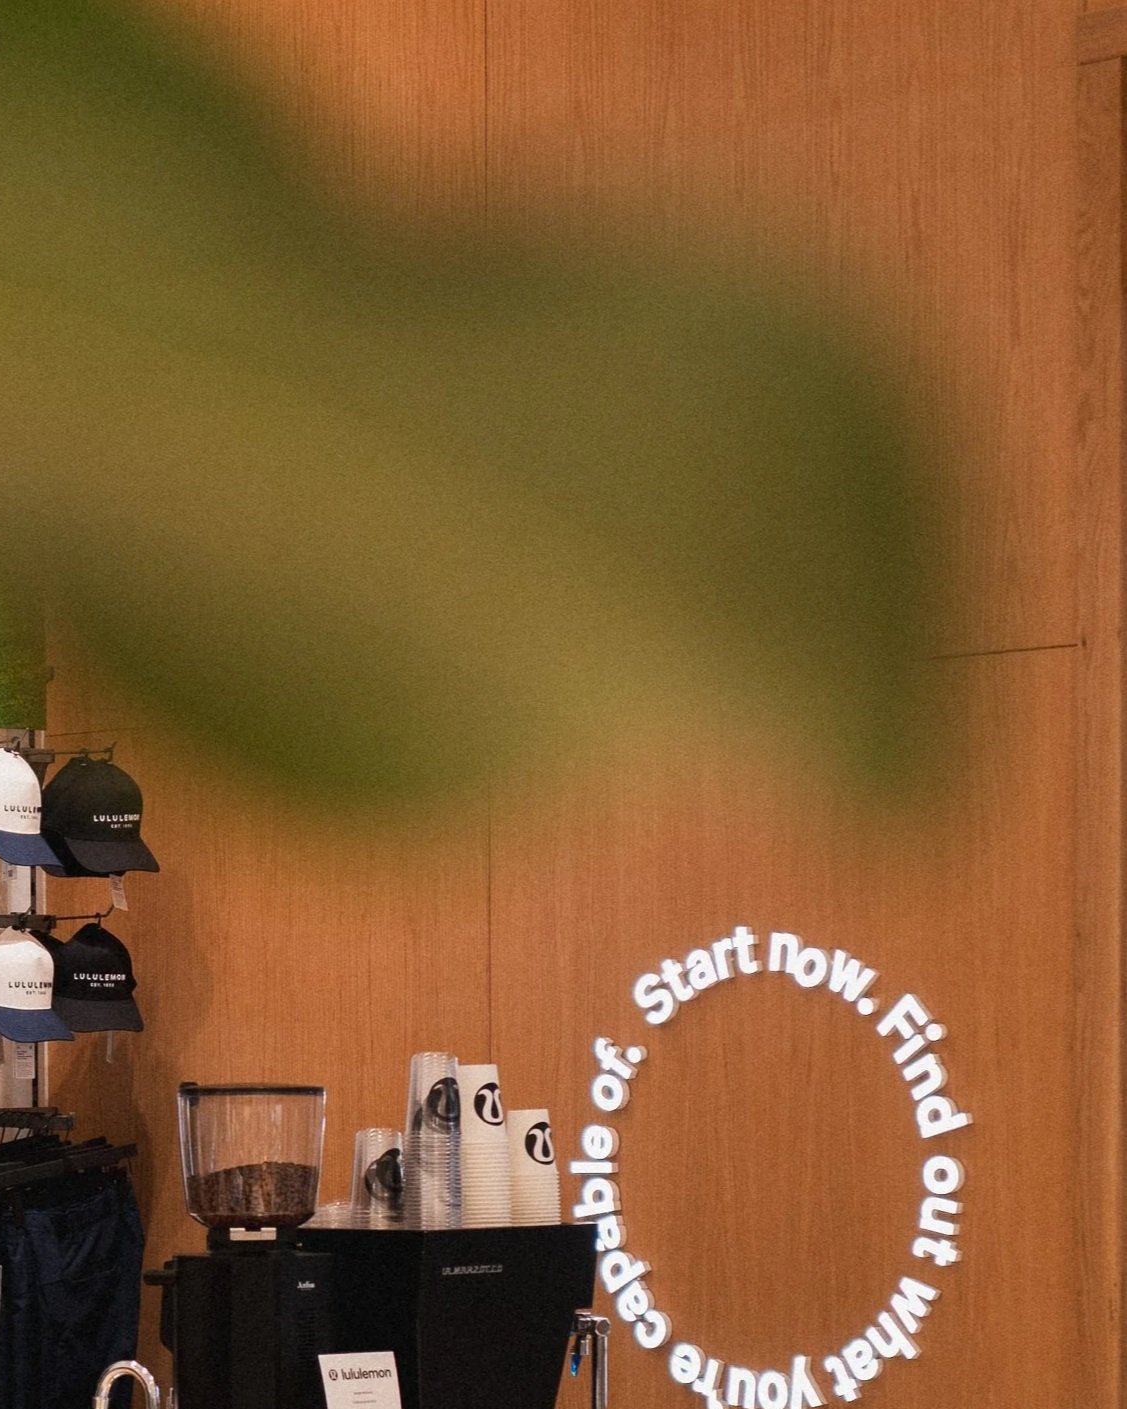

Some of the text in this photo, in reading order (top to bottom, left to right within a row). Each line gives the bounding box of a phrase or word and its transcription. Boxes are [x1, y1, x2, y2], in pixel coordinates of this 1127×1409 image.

[634, 926, 759, 1025] Start
[769, 931, 879, 1016] now.
[592, 1037, 647, 1112] of.
[877, 993, 973, 1139] Find
[570, 1123, 672, 1349] capable
[912, 1155, 965, 1266] out
[341, 1368, 392, 1380] lululemon
[823, 1277, 941, 1401] what
